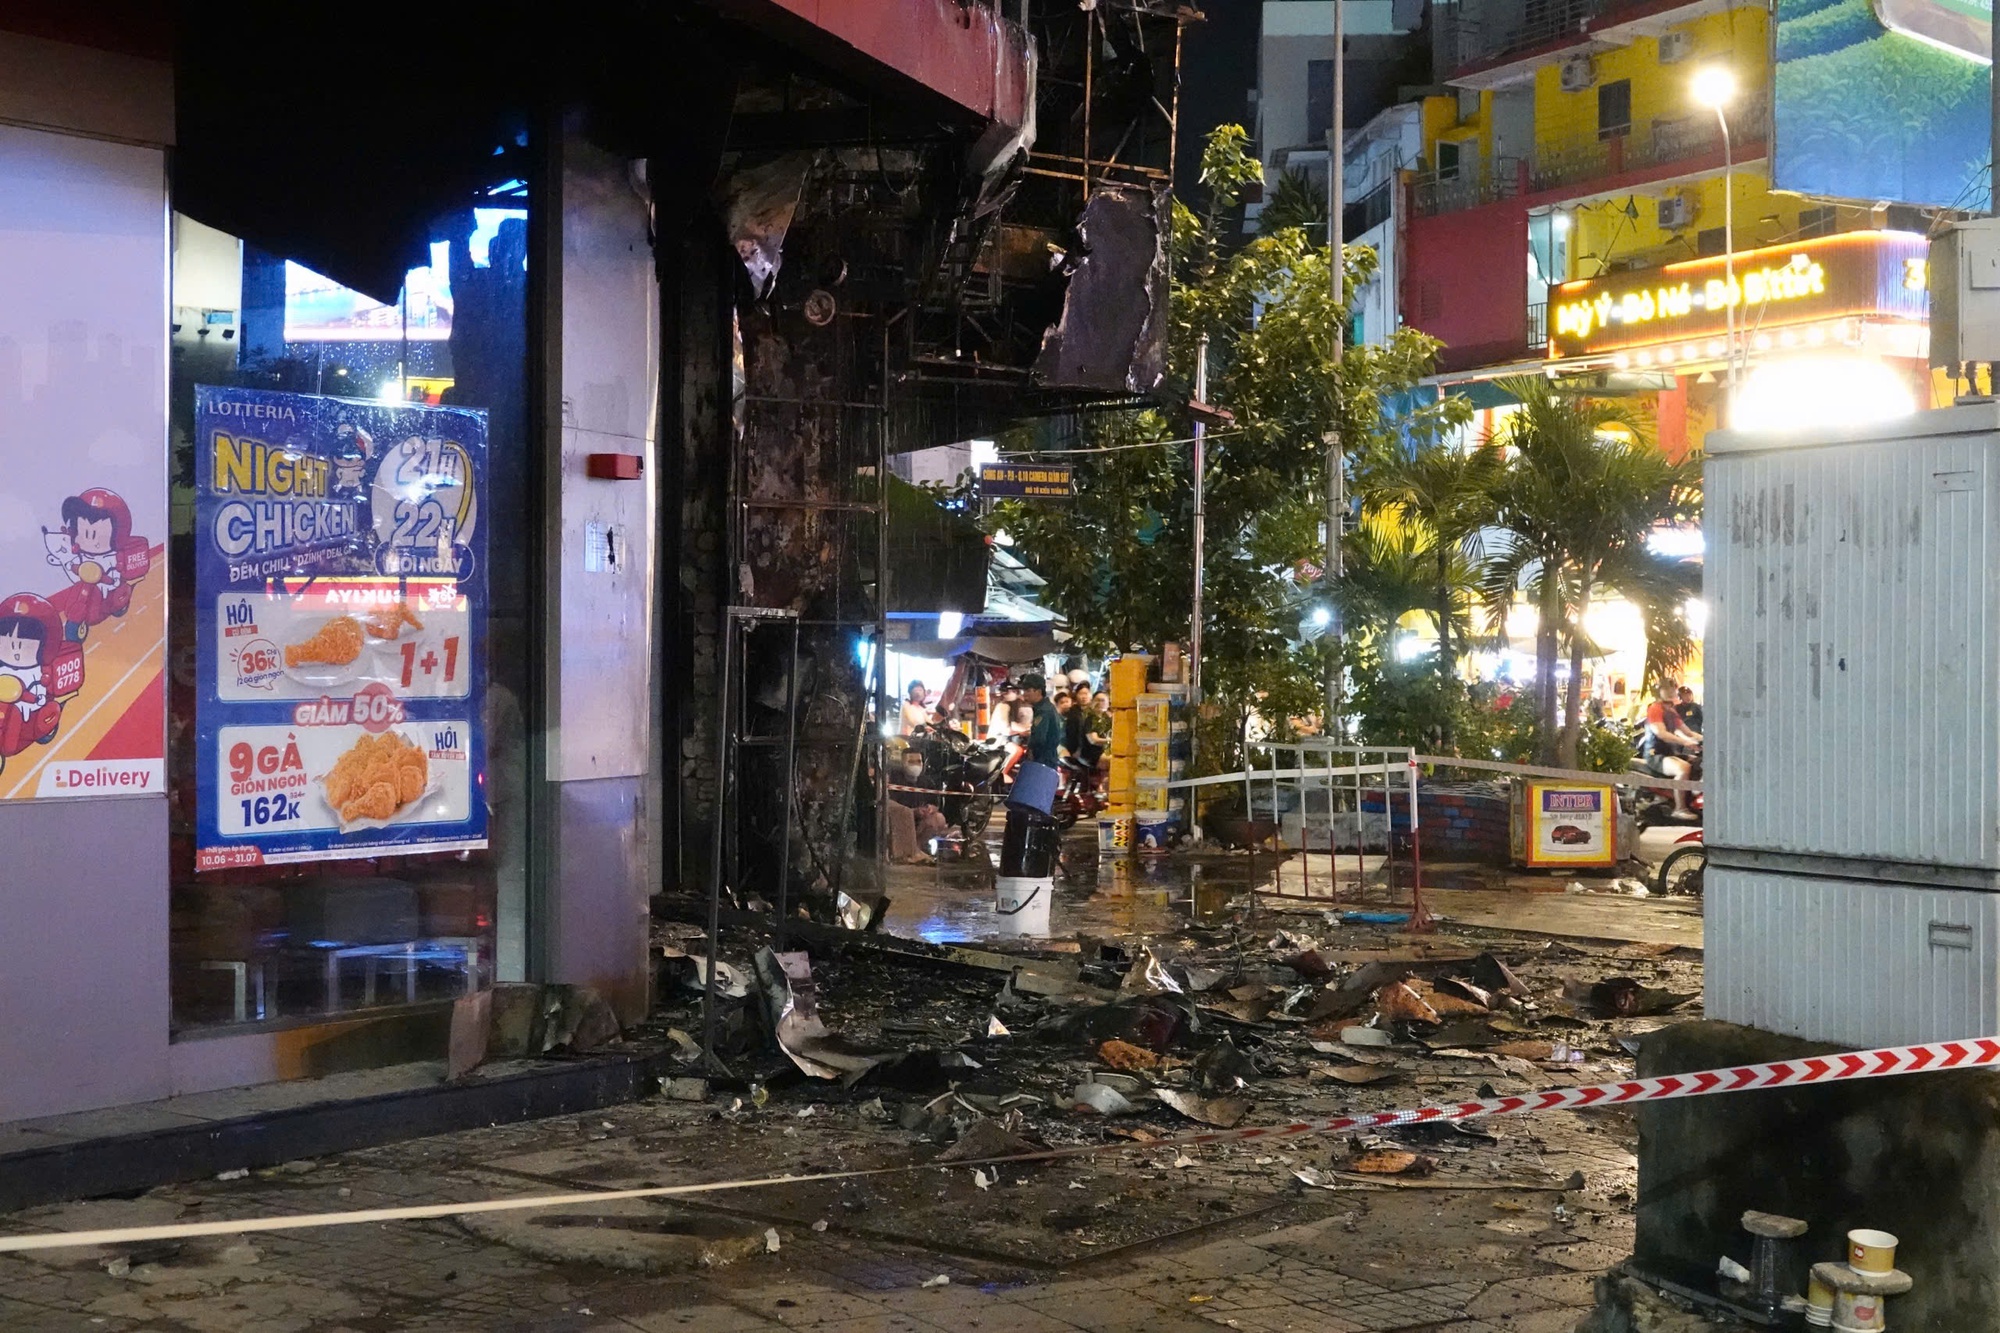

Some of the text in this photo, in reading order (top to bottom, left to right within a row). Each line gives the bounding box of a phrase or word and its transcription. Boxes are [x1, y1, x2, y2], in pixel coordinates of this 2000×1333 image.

[209, 401, 295, 420] LOTTERIA
[213, 432, 329, 497] NIGHT
[216, 502, 354, 555] CHICKEN
[128, 551, 146, 564] FREE
[229, 561, 259, 583] ĐÊM
[262, 556, 291, 575] CHILL
[56, 658, 80, 676] 1900
[242, 650, 276, 674] 36K
[57, 671, 80, 689] 6778
[354, 695, 403, 722] 50%
[229, 733, 303, 782] 9 GÀ
[68, 767, 150, 788] Delivery
[268, 773, 307, 790] NGON
[241, 793, 300, 827] 162K
[235, 853, 257, 863] 31.07
